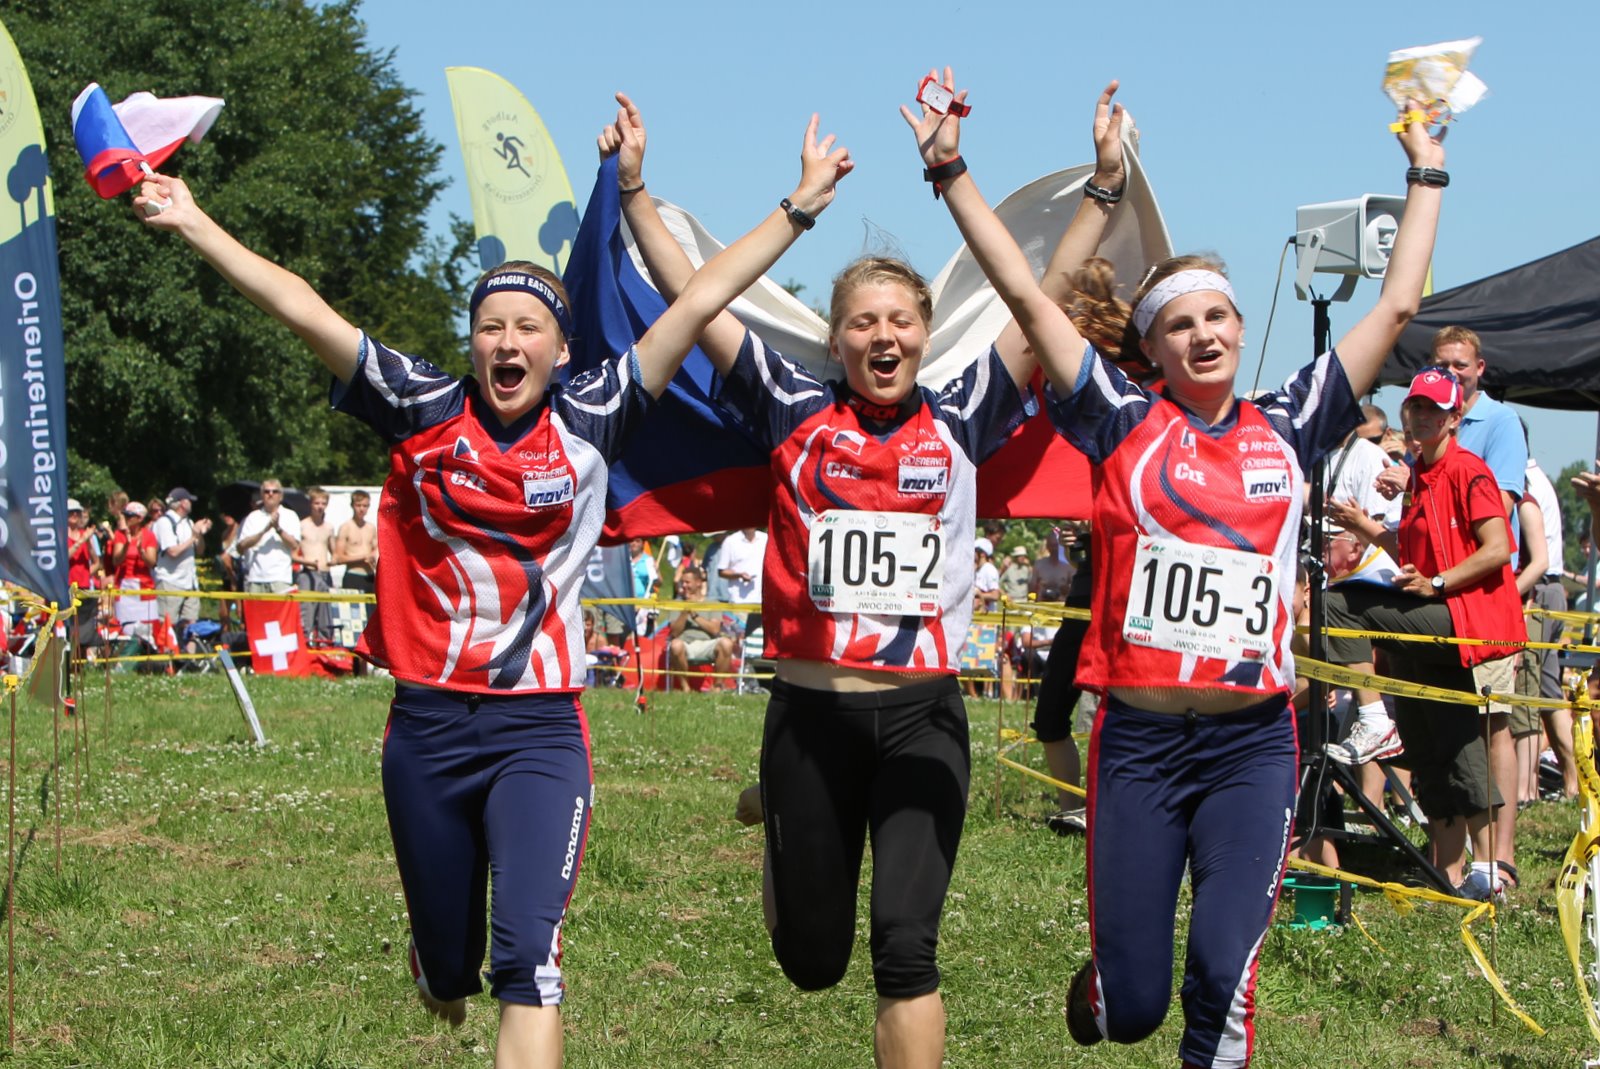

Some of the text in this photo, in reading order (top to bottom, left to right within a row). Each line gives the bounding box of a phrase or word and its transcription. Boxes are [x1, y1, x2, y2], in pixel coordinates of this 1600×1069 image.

[487, 275, 555, 304] PRAGUE EASTER
[818, 528, 941, 589] 105-2
[856, 602, 903, 611] JWOC 2010
[1142, 557, 1273, 636] 105-3
[1173, 638, 1222, 655] JWOC 2010
